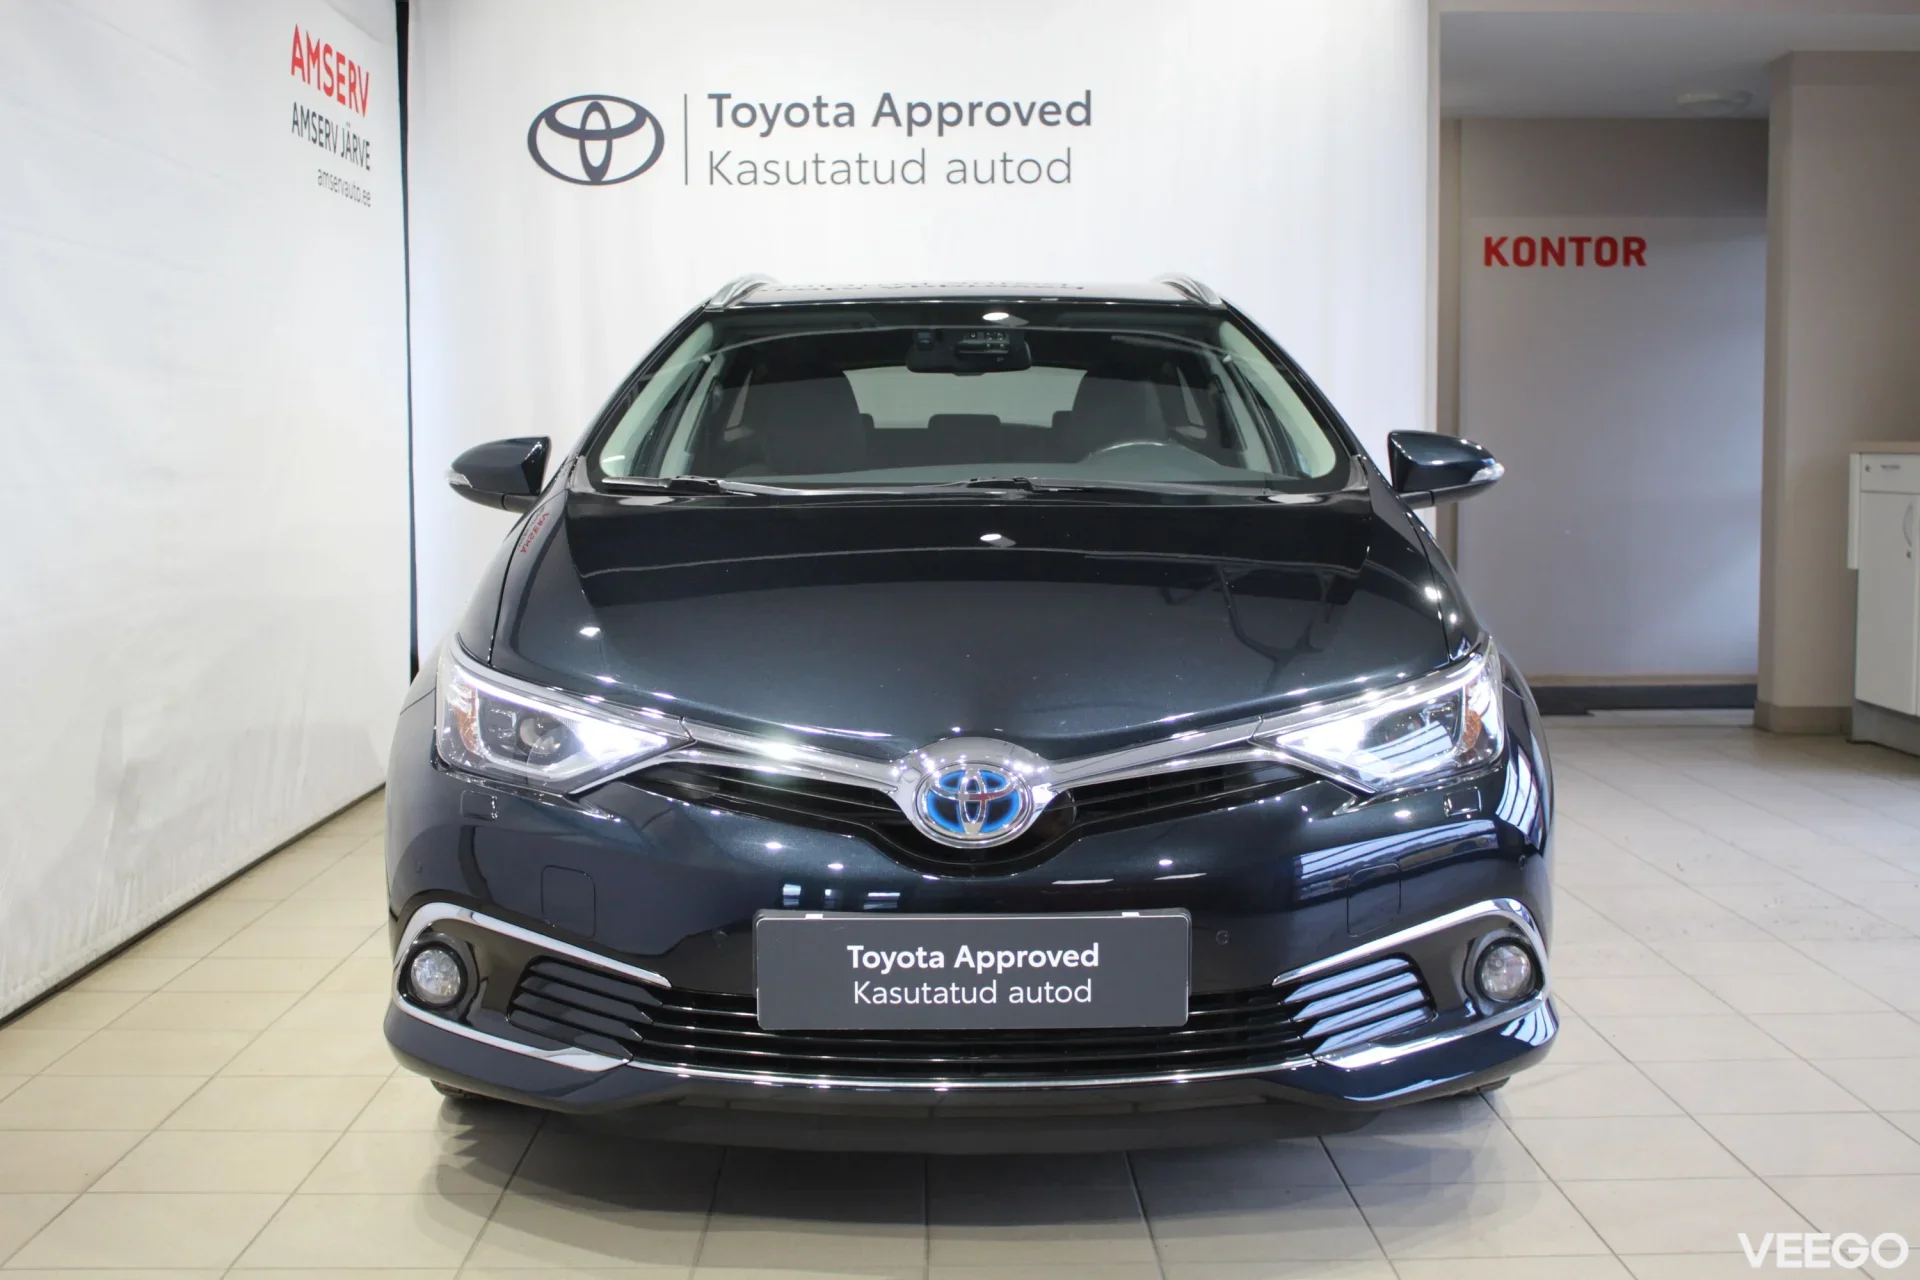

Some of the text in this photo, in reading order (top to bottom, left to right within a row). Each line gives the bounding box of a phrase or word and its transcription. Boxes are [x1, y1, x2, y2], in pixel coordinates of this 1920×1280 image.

[291, 23, 369, 117] AMSERV
[708, 89, 1092, 138] Toyota Approved
[291, 101, 370, 171] AMSERV JÄRVE
[708, 146, 1072, 186] Kasutatud autod
[316, 168, 371, 207] amservauto.ee
[1484, 236, 1648, 267] KONTOR
[847, 942, 1100, 975] Toyota Approved
[853, 978, 1092, 1005] Kasutatud autod
